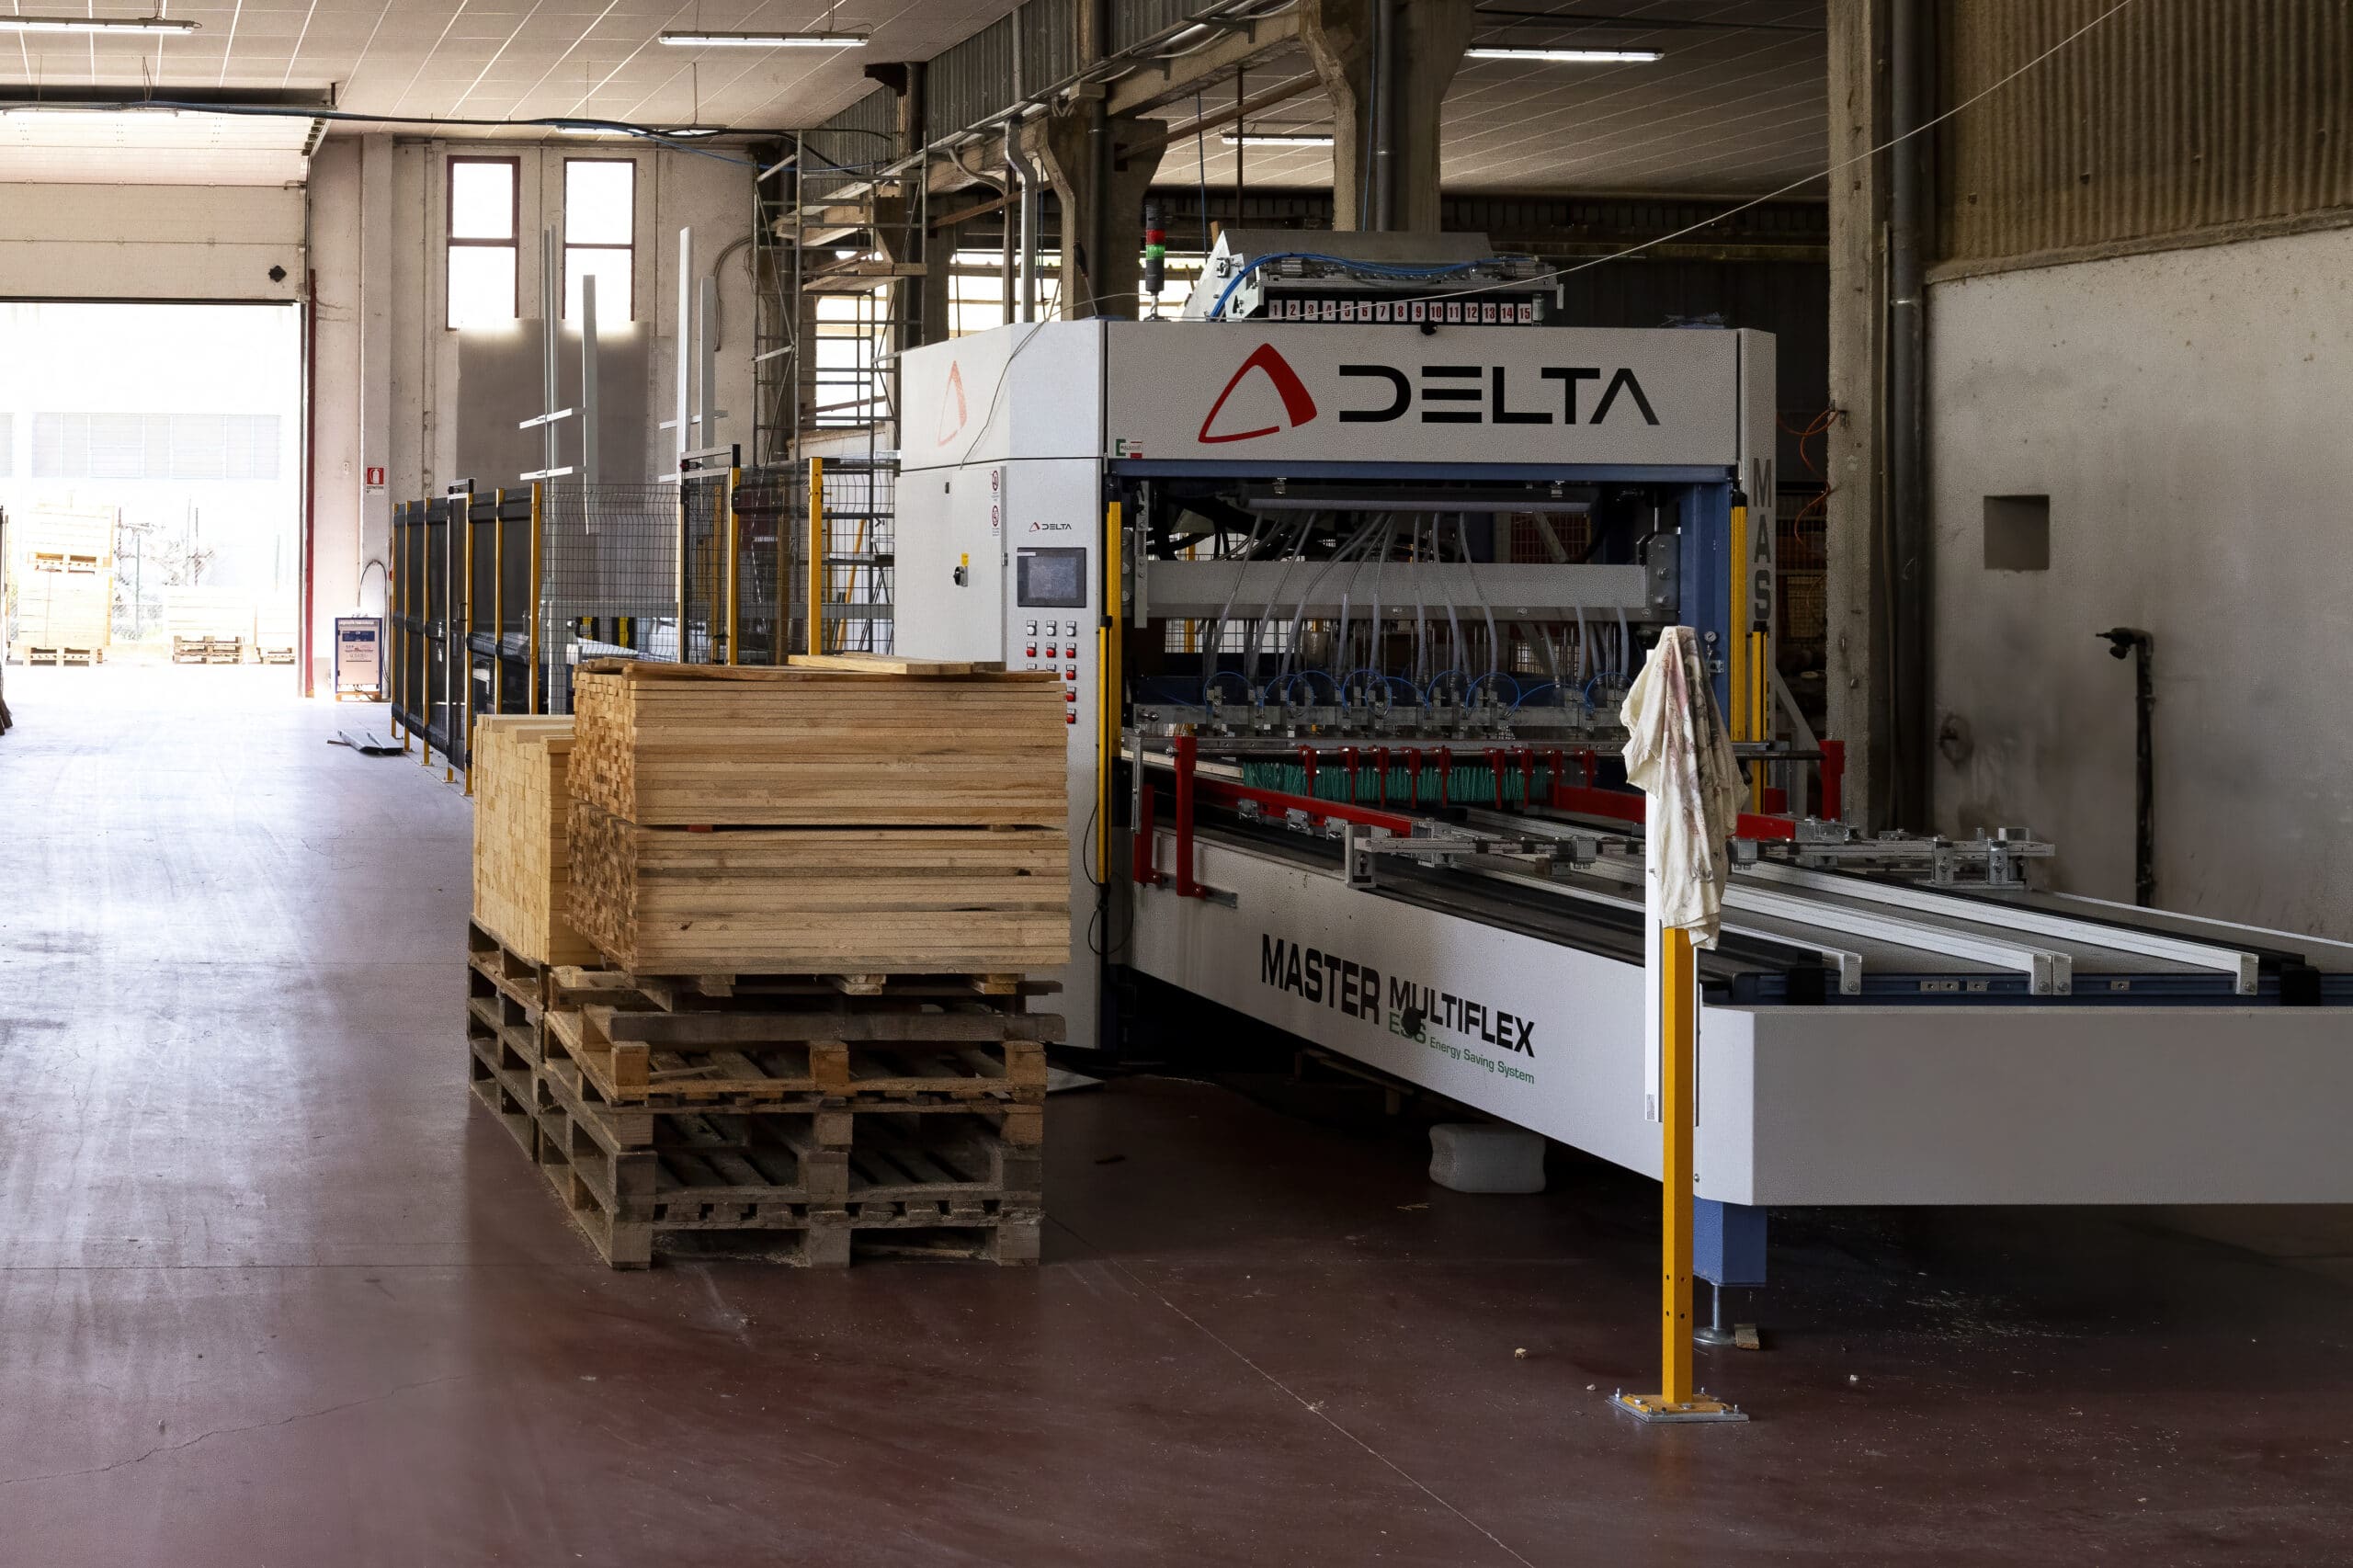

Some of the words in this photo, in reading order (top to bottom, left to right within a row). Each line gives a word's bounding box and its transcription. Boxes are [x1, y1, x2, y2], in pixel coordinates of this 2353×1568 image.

[1430, 306, 1442, 318] 10
[1449, 306, 1460, 318] 11
[1466, 306, 1477, 318] 12
[1483, 307, 1495, 319] 13
[1502, 307, 1513, 319] 14
[1519, 307, 1530, 319] 15
[1338, 364, 1661, 426] DELTA
[1261, 933, 1381, 1026] MASTER
[1389, 975, 1536, 1059] MULTIFLEX
[1430, 1037, 1461, 1061] Energy
[1463, 1049, 1495, 1074] Saving
[1497, 1060, 1535, 1085] System
